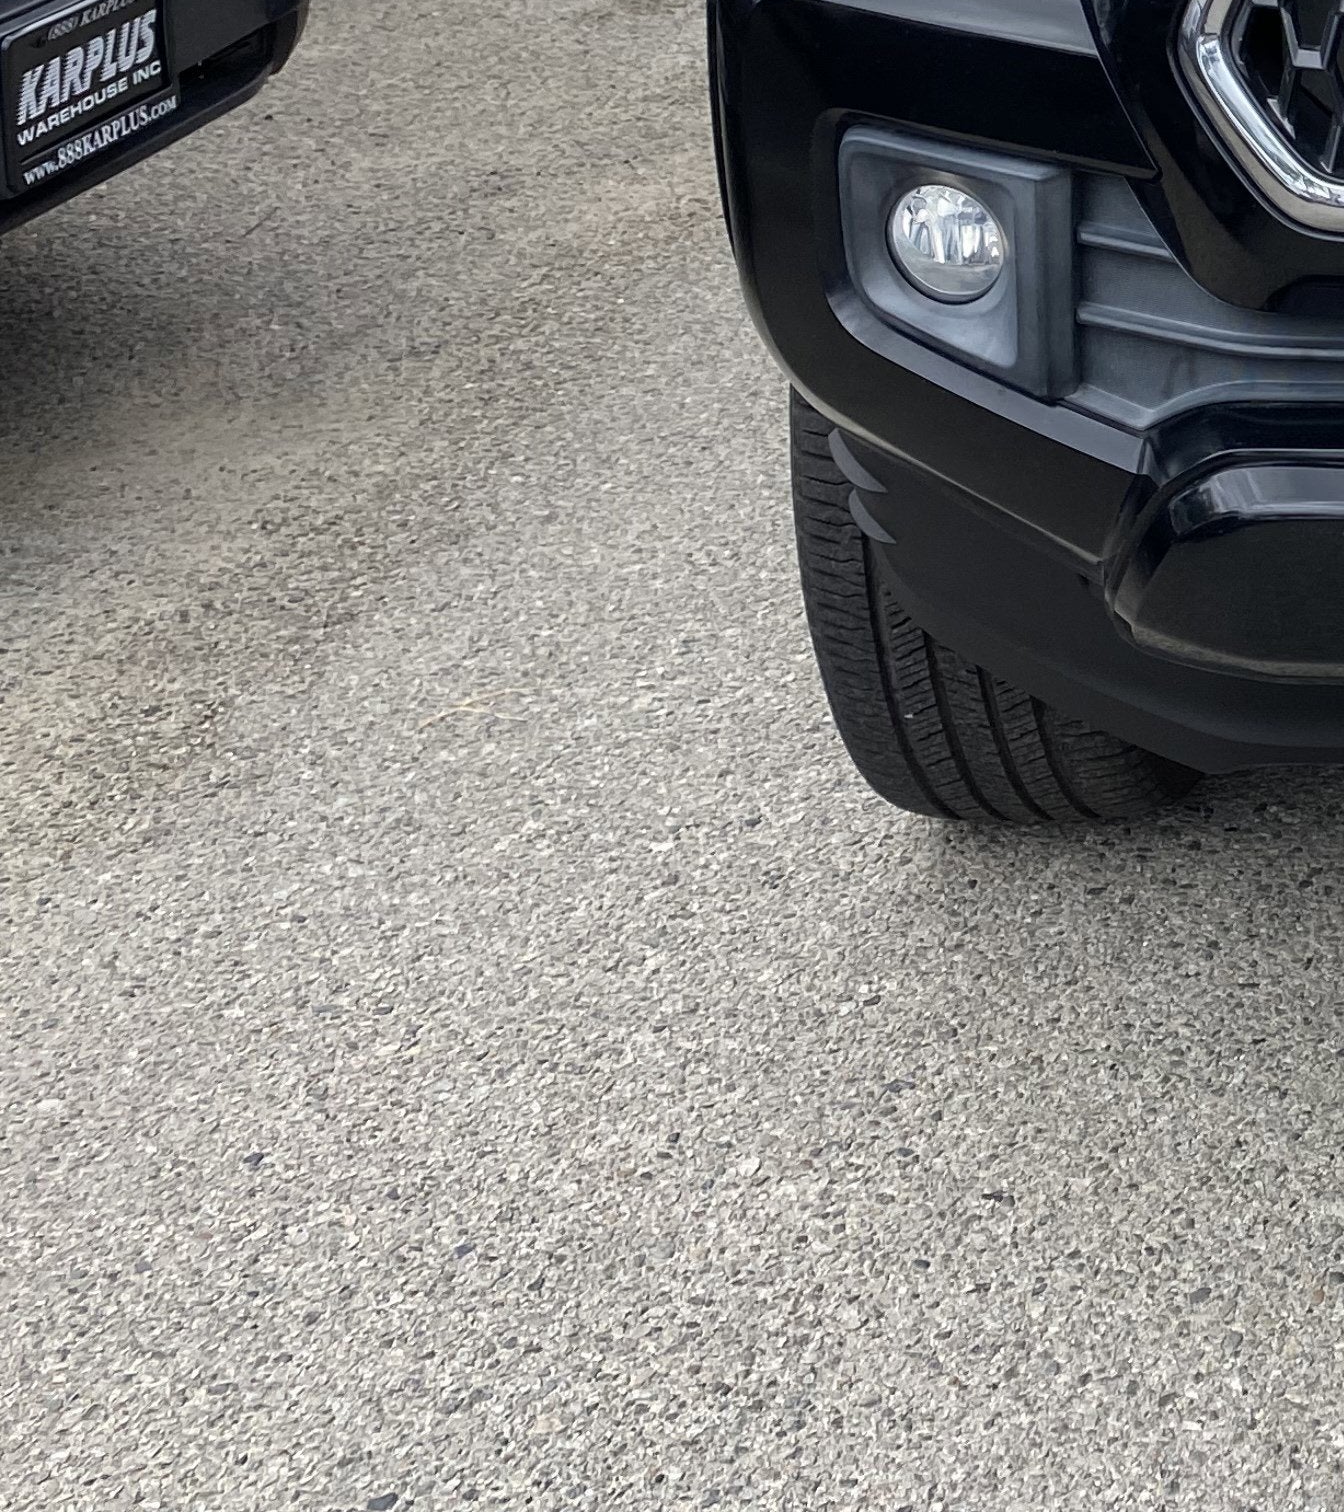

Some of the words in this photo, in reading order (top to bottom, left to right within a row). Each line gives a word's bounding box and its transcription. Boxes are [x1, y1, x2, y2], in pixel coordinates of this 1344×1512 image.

[16, 8, 157, 126] KARPLUS
[17, 76, 128, 146] WAREHOUSE
[132, 59, 162, 85] INC
